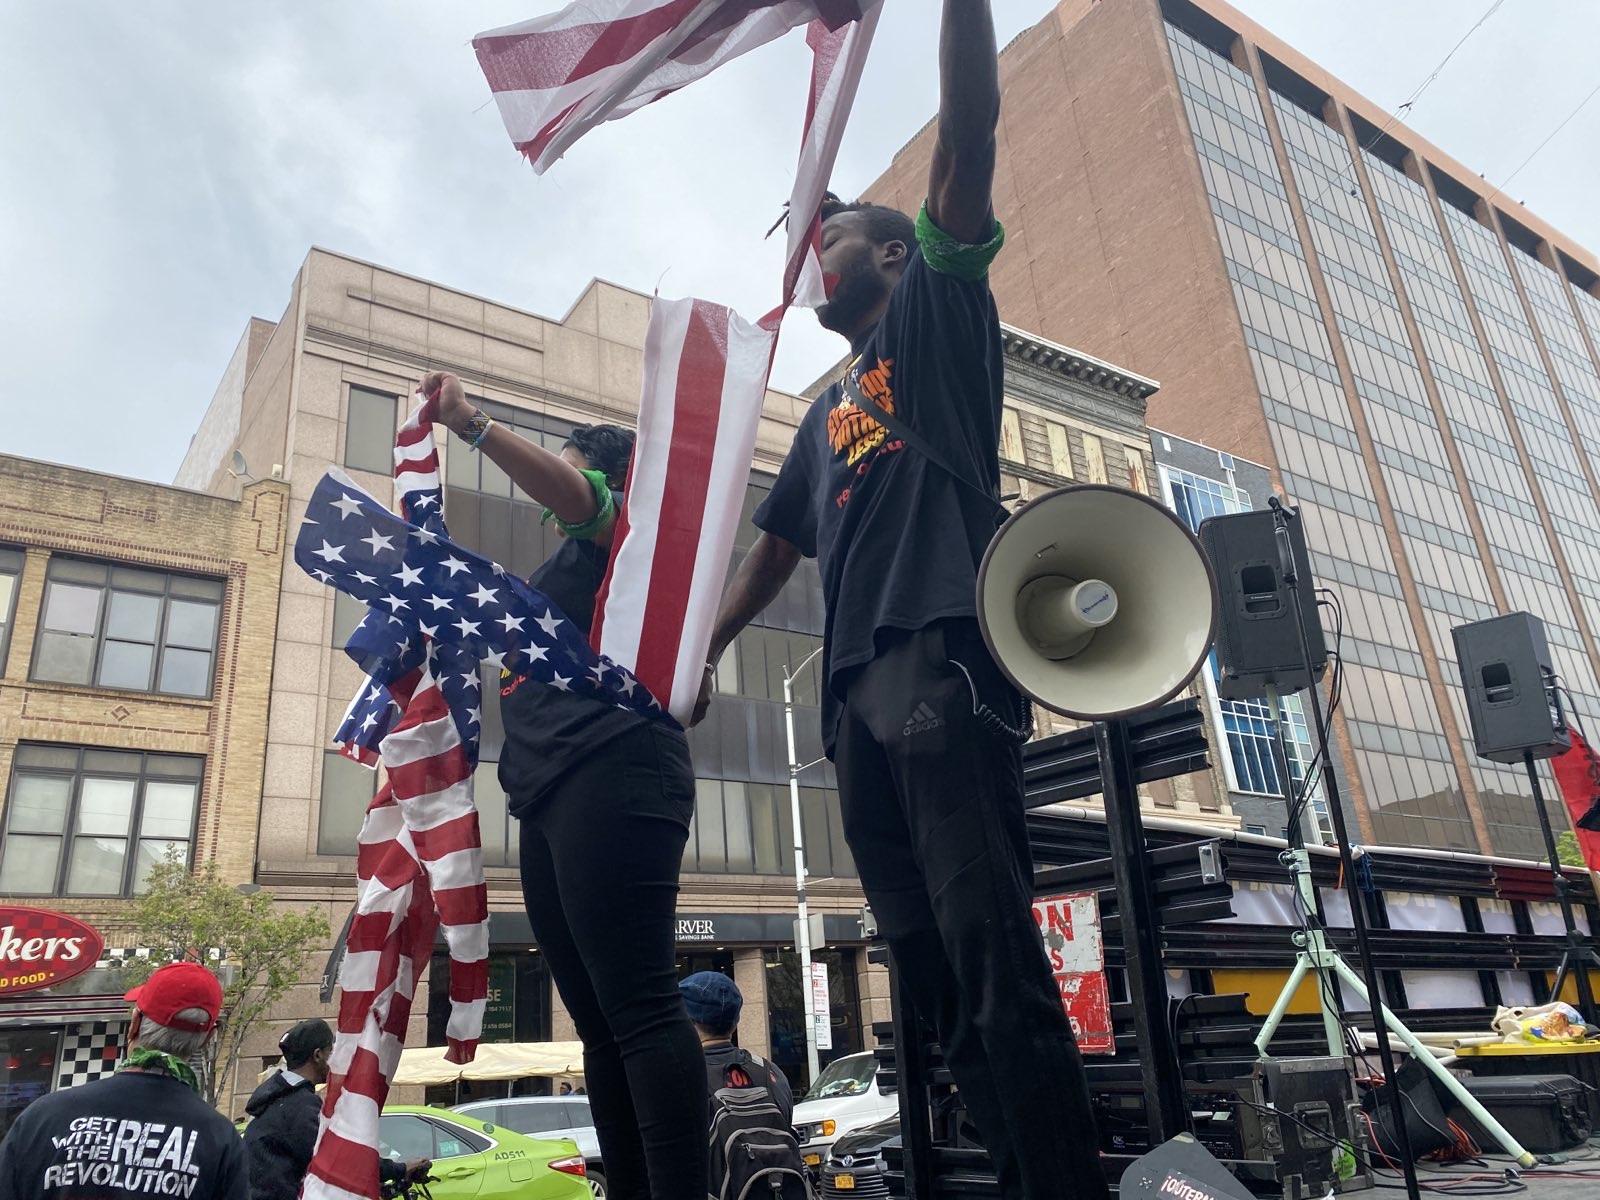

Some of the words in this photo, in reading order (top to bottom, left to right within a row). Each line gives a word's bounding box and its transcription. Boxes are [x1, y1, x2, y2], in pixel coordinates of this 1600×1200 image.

[903, 718, 946, 737] adidas
[0, 926, 82, 961] kers
[12, 972, 46, 987] FOOD
[69, 1116, 117, 1132] GET
[51, 1130, 114, 1150] WITH
[110, 1119, 200, 1177] REAL
[65, 1145, 111, 1161] THE
[43, 1161, 198, 1200] REVOLUTION
